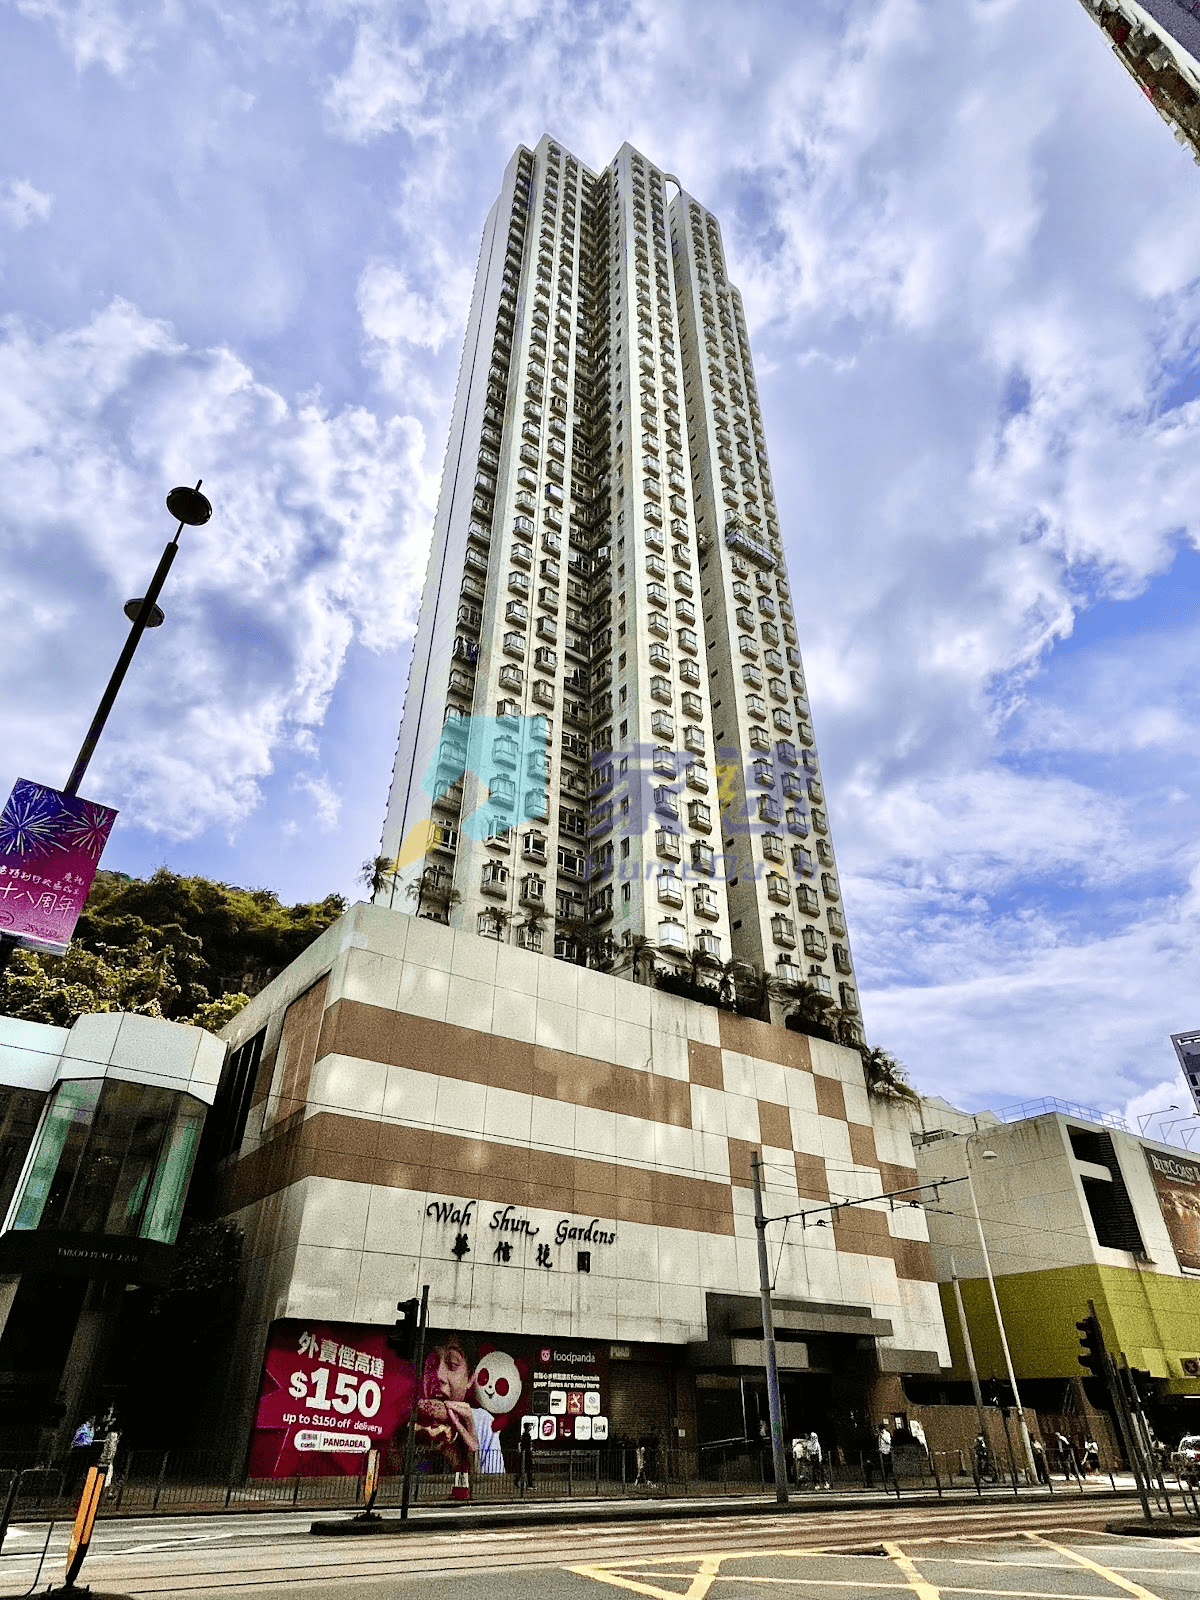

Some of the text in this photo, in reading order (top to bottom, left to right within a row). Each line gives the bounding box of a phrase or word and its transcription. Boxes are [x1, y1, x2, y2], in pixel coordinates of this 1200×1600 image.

[426, 1200, 616, 1245] Wah Shun Gardens
[297, 1331, 384, 1379] 外賣慳高達
[553, 1350, 596, 1364] foodpanda
[288, 1367, 381, 1418] $150
[282, 1413, 297, 1425] up
[299, 1414, 311, 1424] to
[337, 1419, 351, 1428] off
[354, 1420, 383, 1435] delivery
[322, 1437, 367, 1448] PANDADEAL
